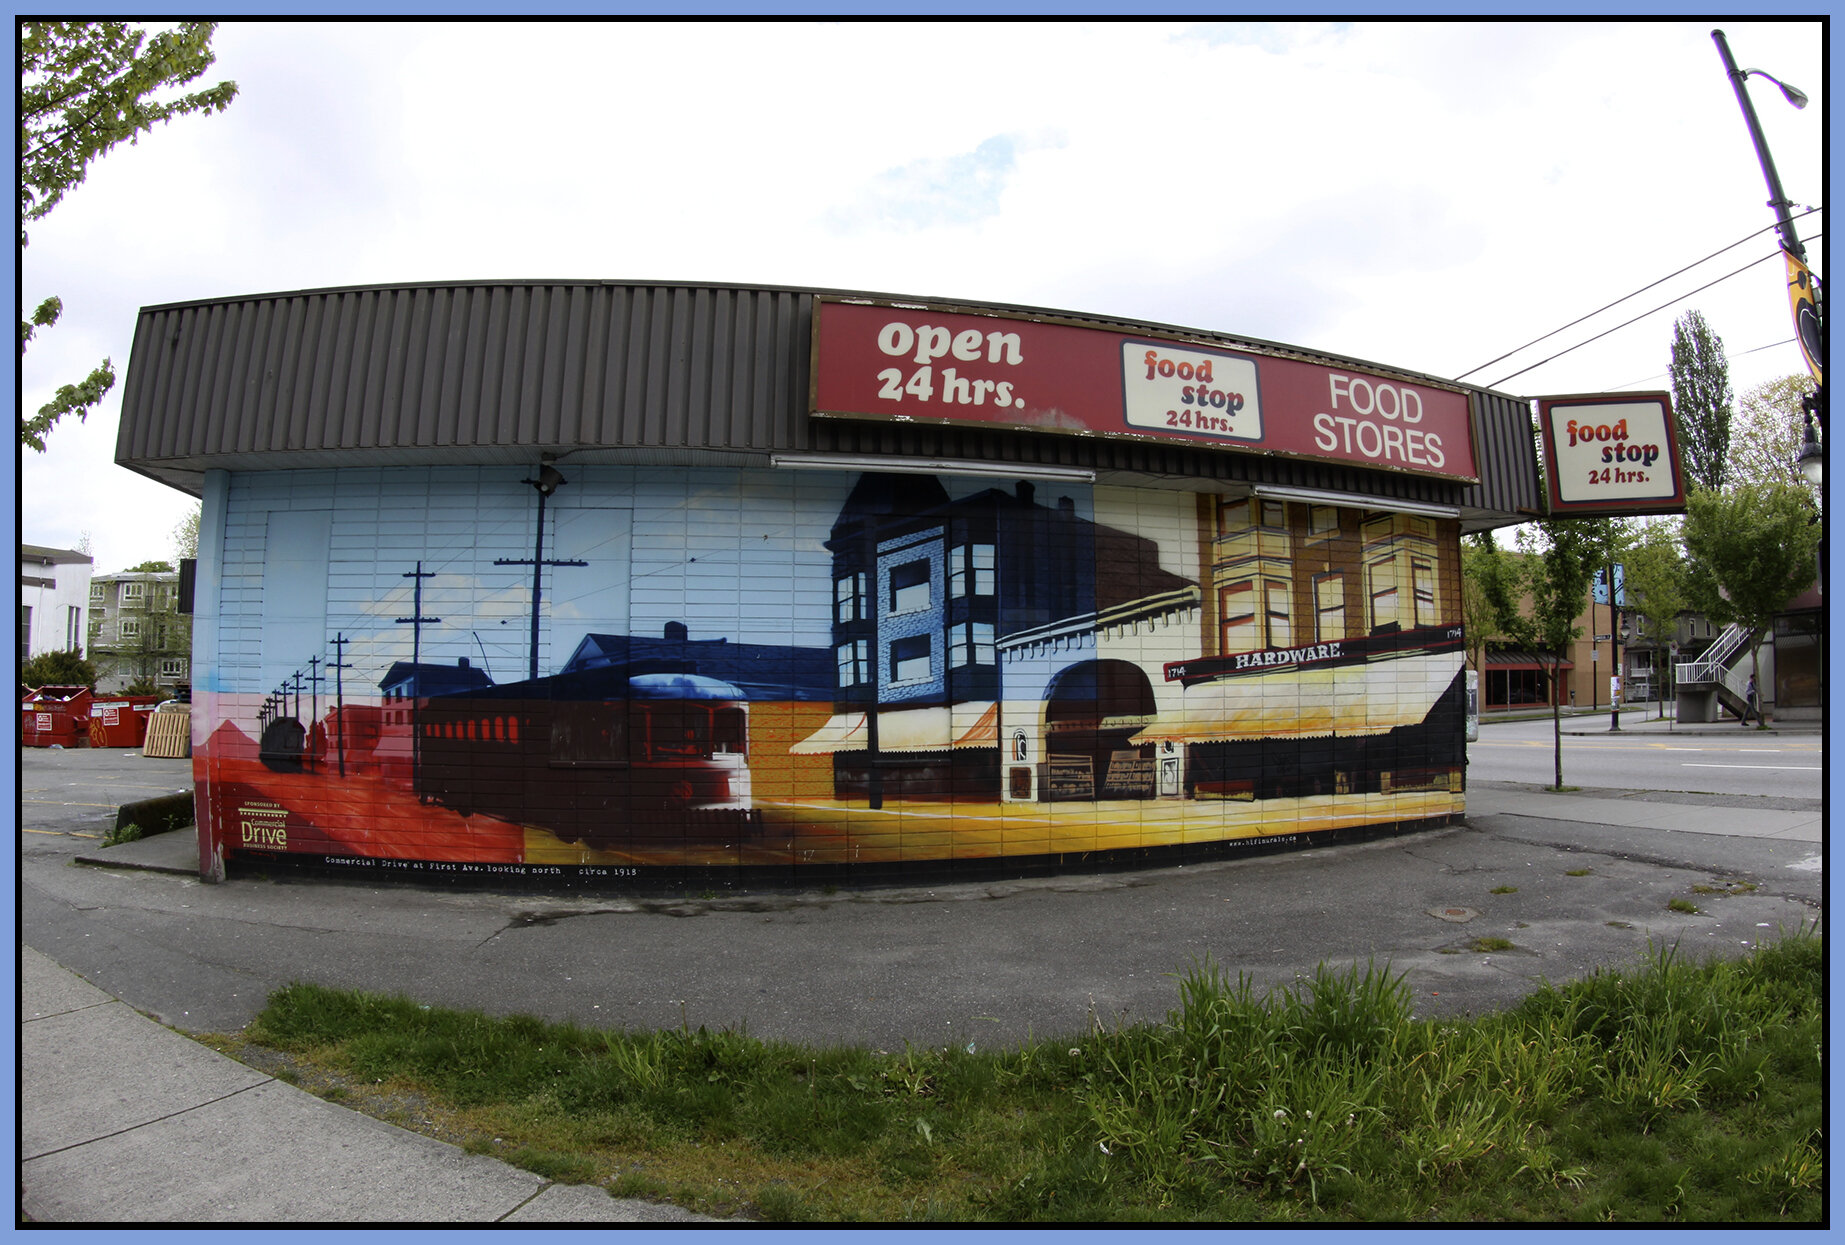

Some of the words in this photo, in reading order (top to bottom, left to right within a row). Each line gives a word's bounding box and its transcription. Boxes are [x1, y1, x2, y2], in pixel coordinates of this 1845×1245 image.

[877, 322, 1024, 366] open
[1144, 350, 1214, 384] food
[877, 365, 934, 402] 24
[941, 367, 1025, 409] hrs.
[1328, 373, 1423, 424] FOOD
[1181, 384, 1244, 417] stop
[1166, 409, 1192, 427] 24
[1195, 410, 1234, 432] hrs.
[1566, 418, 1629, 447] food
[1313, 412, 1445, 468] STORES
[1601, 442, 1659, 467] stop
[1588, 467, 1611, 485] 24
[1614, 467, 1650, 484] hrs.
[1235, 642, 1345, 669] HARDWARE.
[1167, 665, 1186, 678] 1714
[241, 821, 287, 845] Drive
[251, 818, 286, 828] Commercial
[325, 856, 376, 866] Commercial
[382, 859, 408, 868] Drive
[430, 862, 457, 871] First
[462, 864, 484, 872] Ave.
[487, 864, 527, 874] looking
[578, 868, 608, 876] circa
